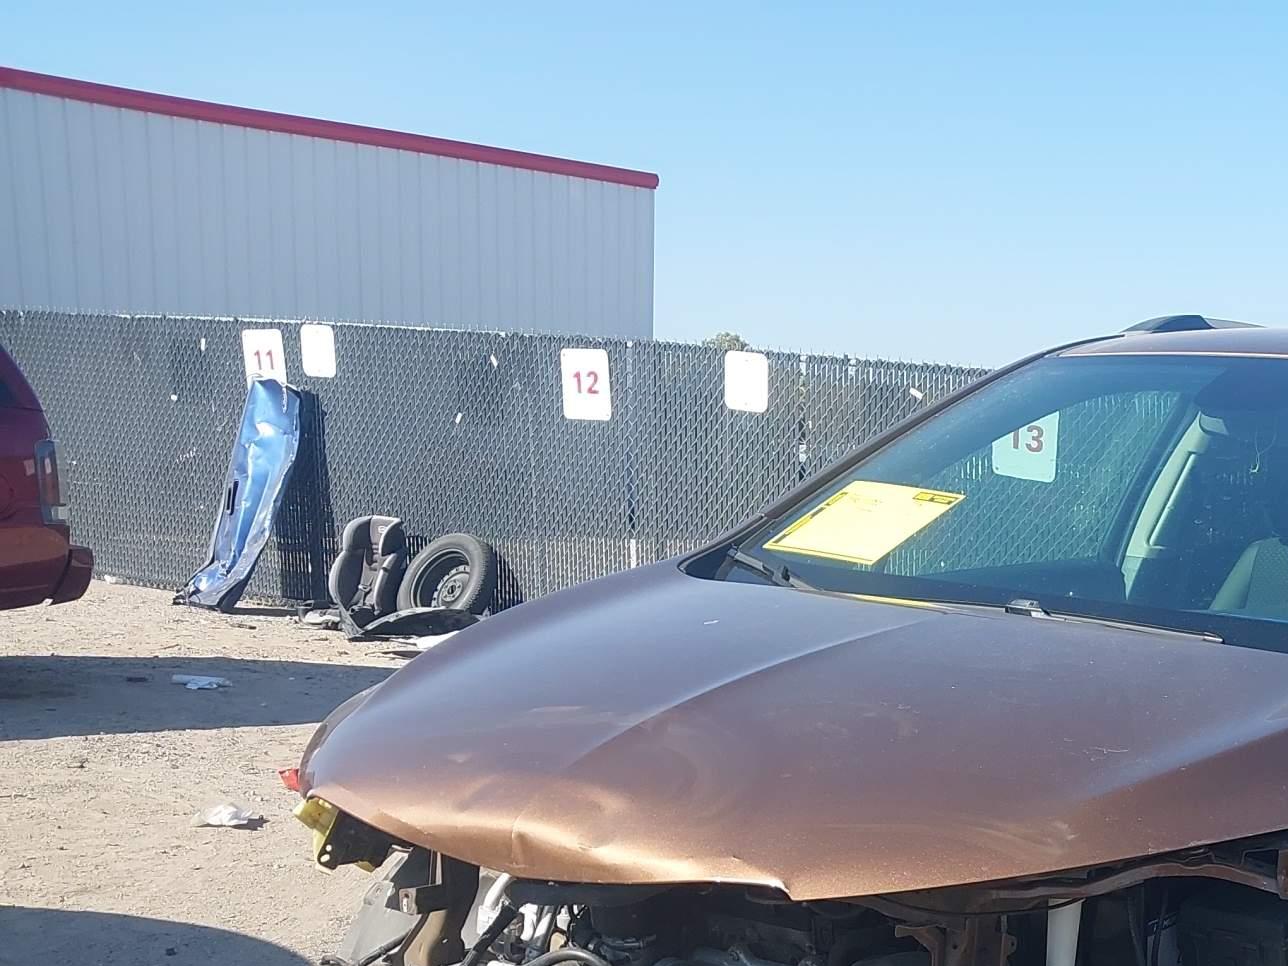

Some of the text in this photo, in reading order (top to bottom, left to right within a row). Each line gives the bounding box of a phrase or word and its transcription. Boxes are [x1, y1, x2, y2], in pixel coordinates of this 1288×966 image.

[253, 349, 275, 371] 11
[572, 370, 600, 395] 12
[1012, 424, 1044, 453] 13
